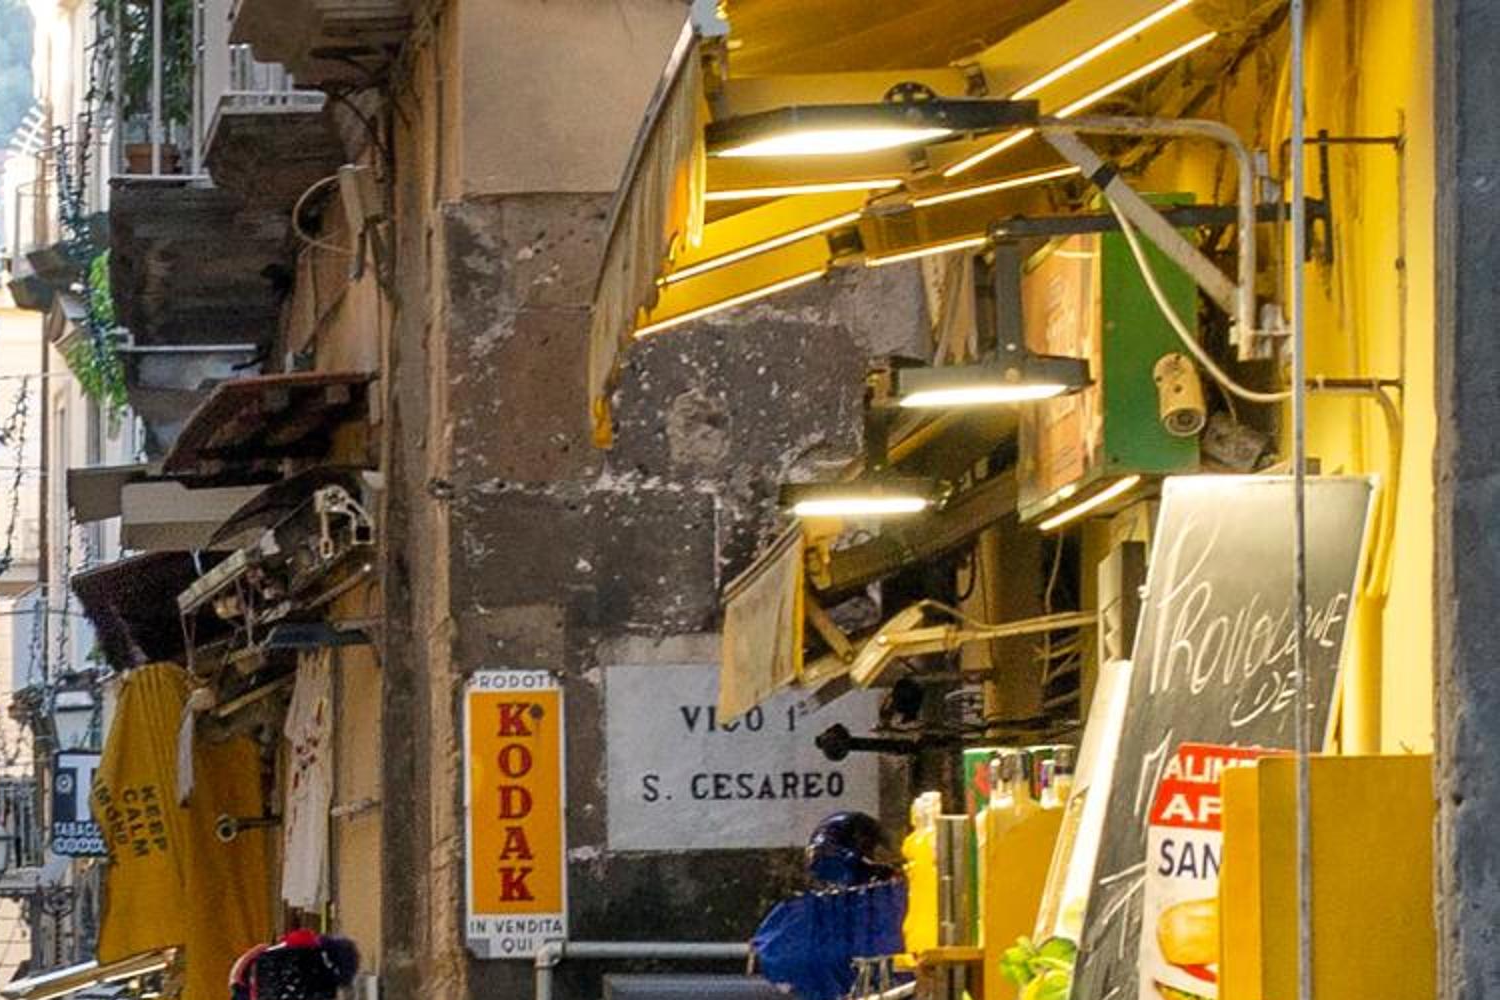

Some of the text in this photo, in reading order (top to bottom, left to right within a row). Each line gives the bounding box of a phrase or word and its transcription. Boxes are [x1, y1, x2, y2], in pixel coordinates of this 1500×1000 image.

[642, 771, 845, 802] S. CESAREO
[496, 702, 534, 902] KODAK
[470, 918, 563, 934] IN VENDITA
[501, 938, 533, 953] QUI
